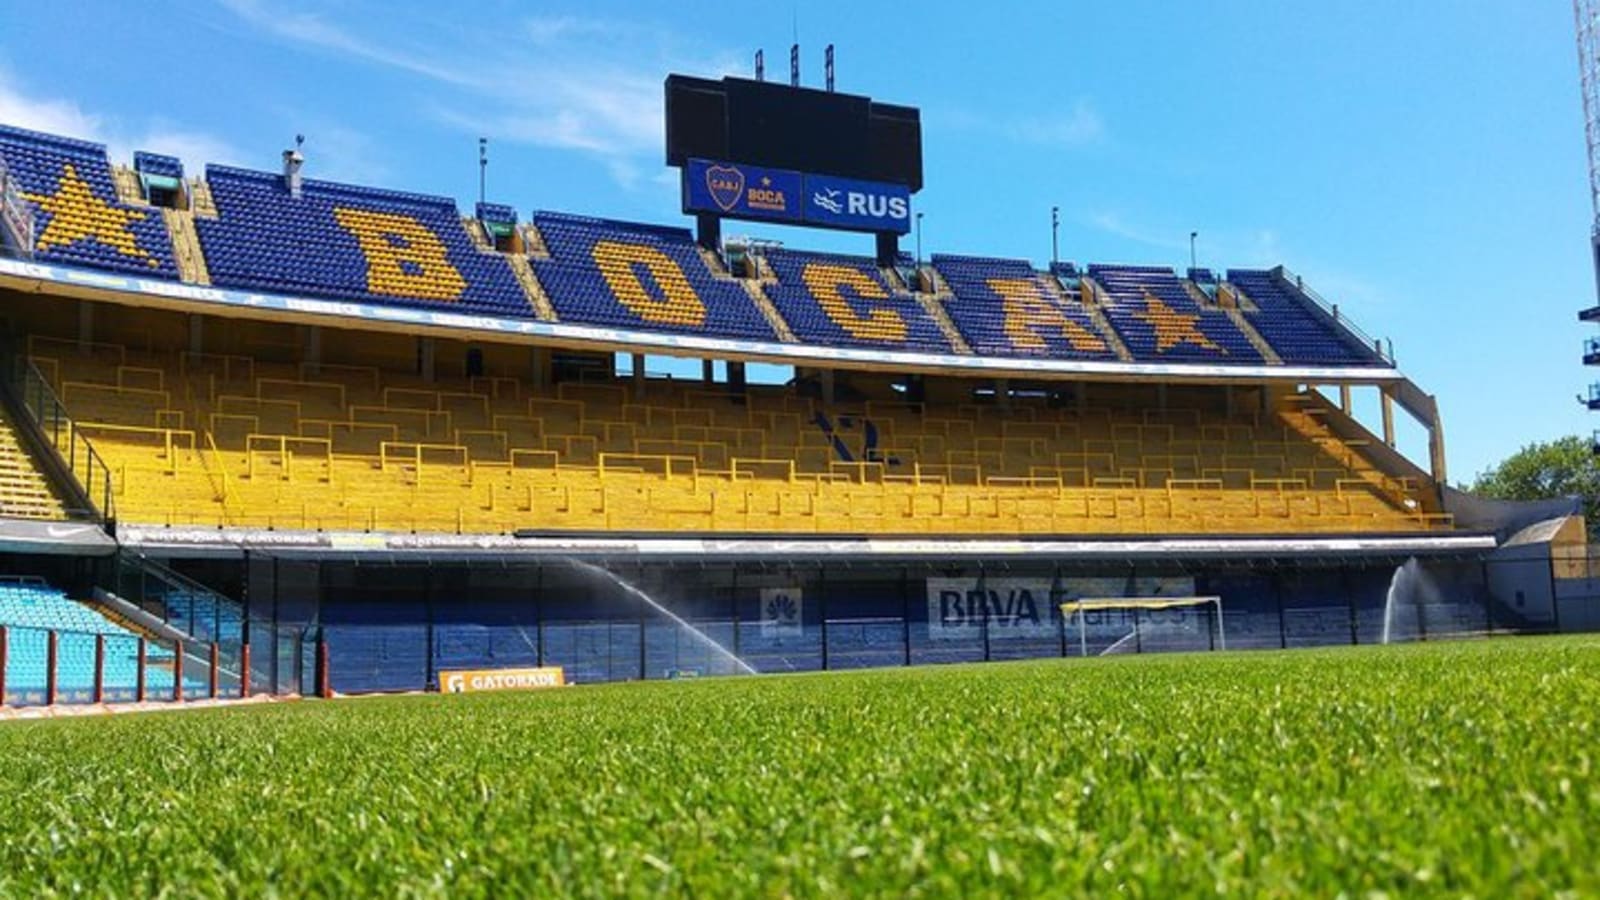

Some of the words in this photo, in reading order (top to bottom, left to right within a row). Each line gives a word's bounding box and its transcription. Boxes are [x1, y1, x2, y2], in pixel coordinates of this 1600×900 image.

[747, 188, 785, 205] BOCA
[848, 191, 908, 219] RUS
[940, 590, 1040, 627] BBVA
[471, 673, 556, 689] GATORADE
